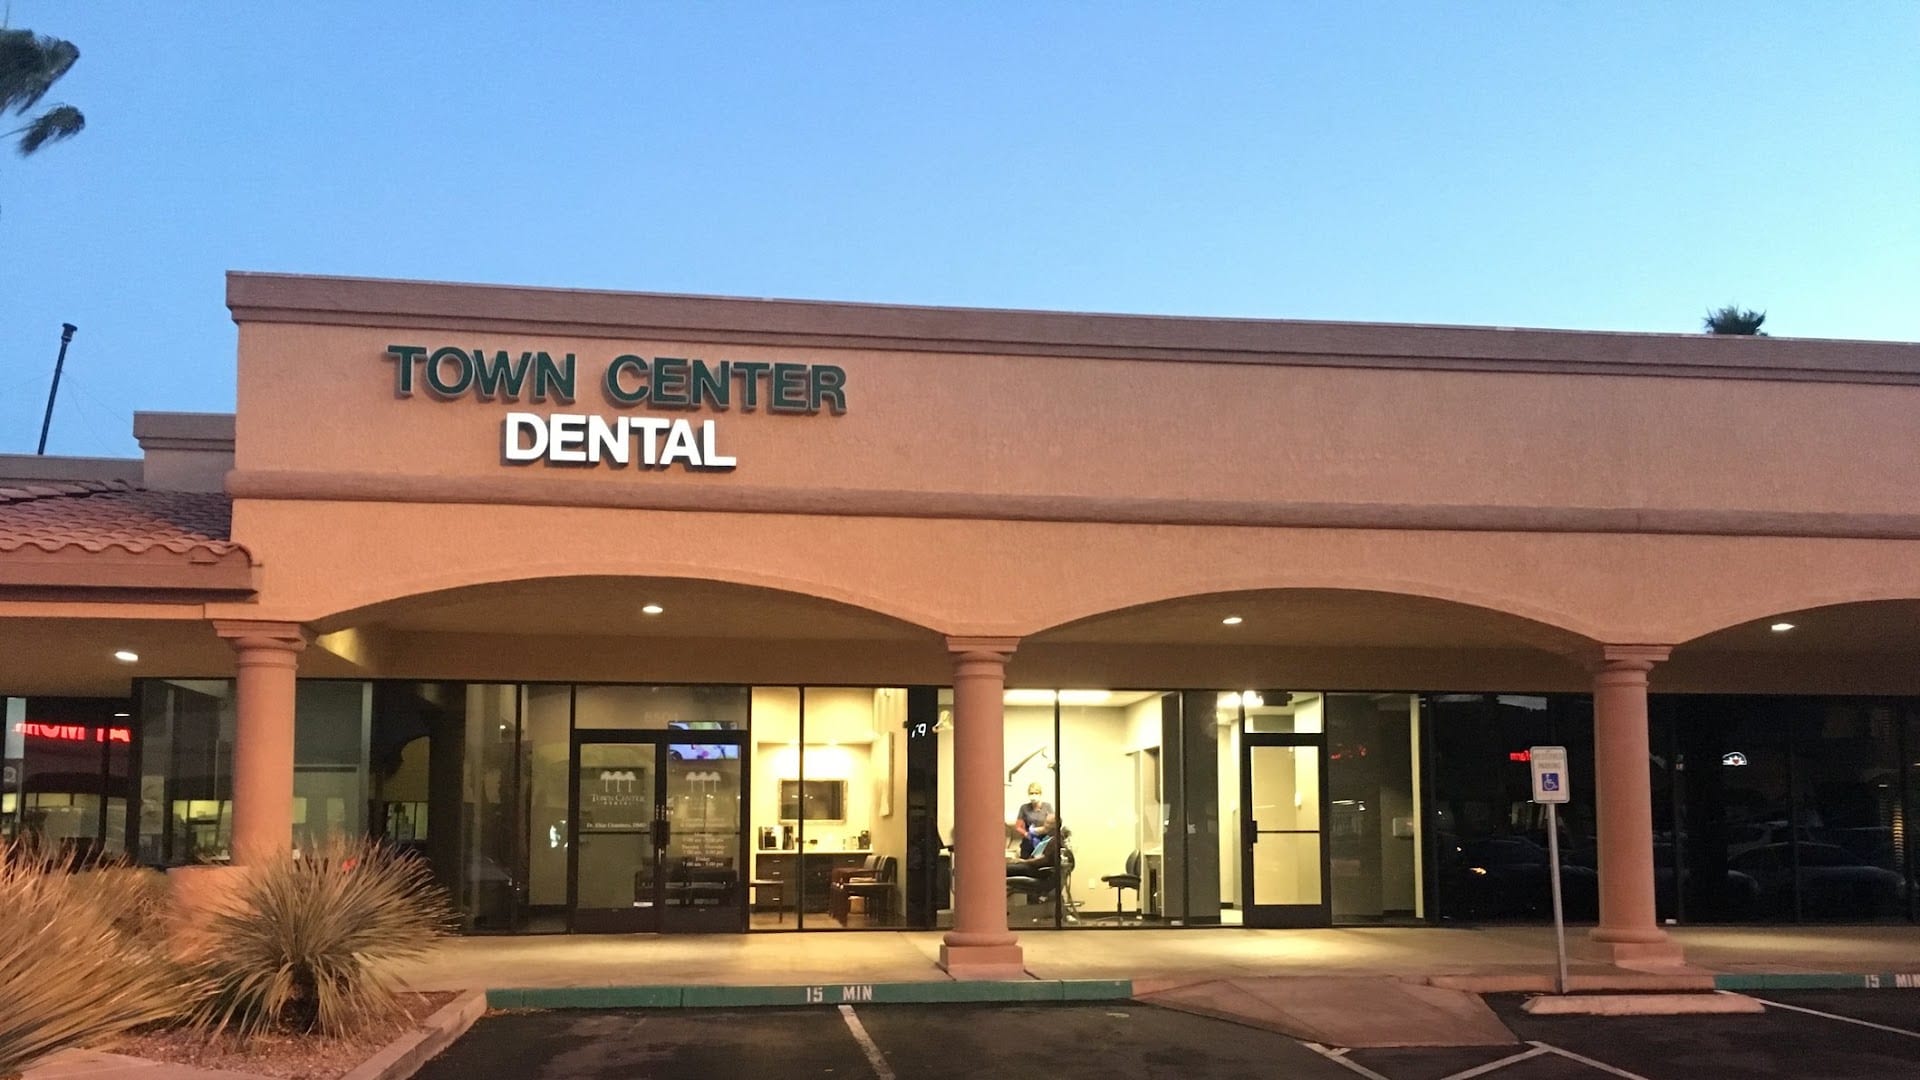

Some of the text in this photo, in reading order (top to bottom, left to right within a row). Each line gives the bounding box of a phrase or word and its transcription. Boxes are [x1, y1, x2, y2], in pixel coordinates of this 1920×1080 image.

[387, 345, 847, 413] TOWN CENTER
[505, 412, 737, 467] DENTAL
[806, 984, 872, 1002] 15 MIN
[1864, 974, 1880, 988] 15
